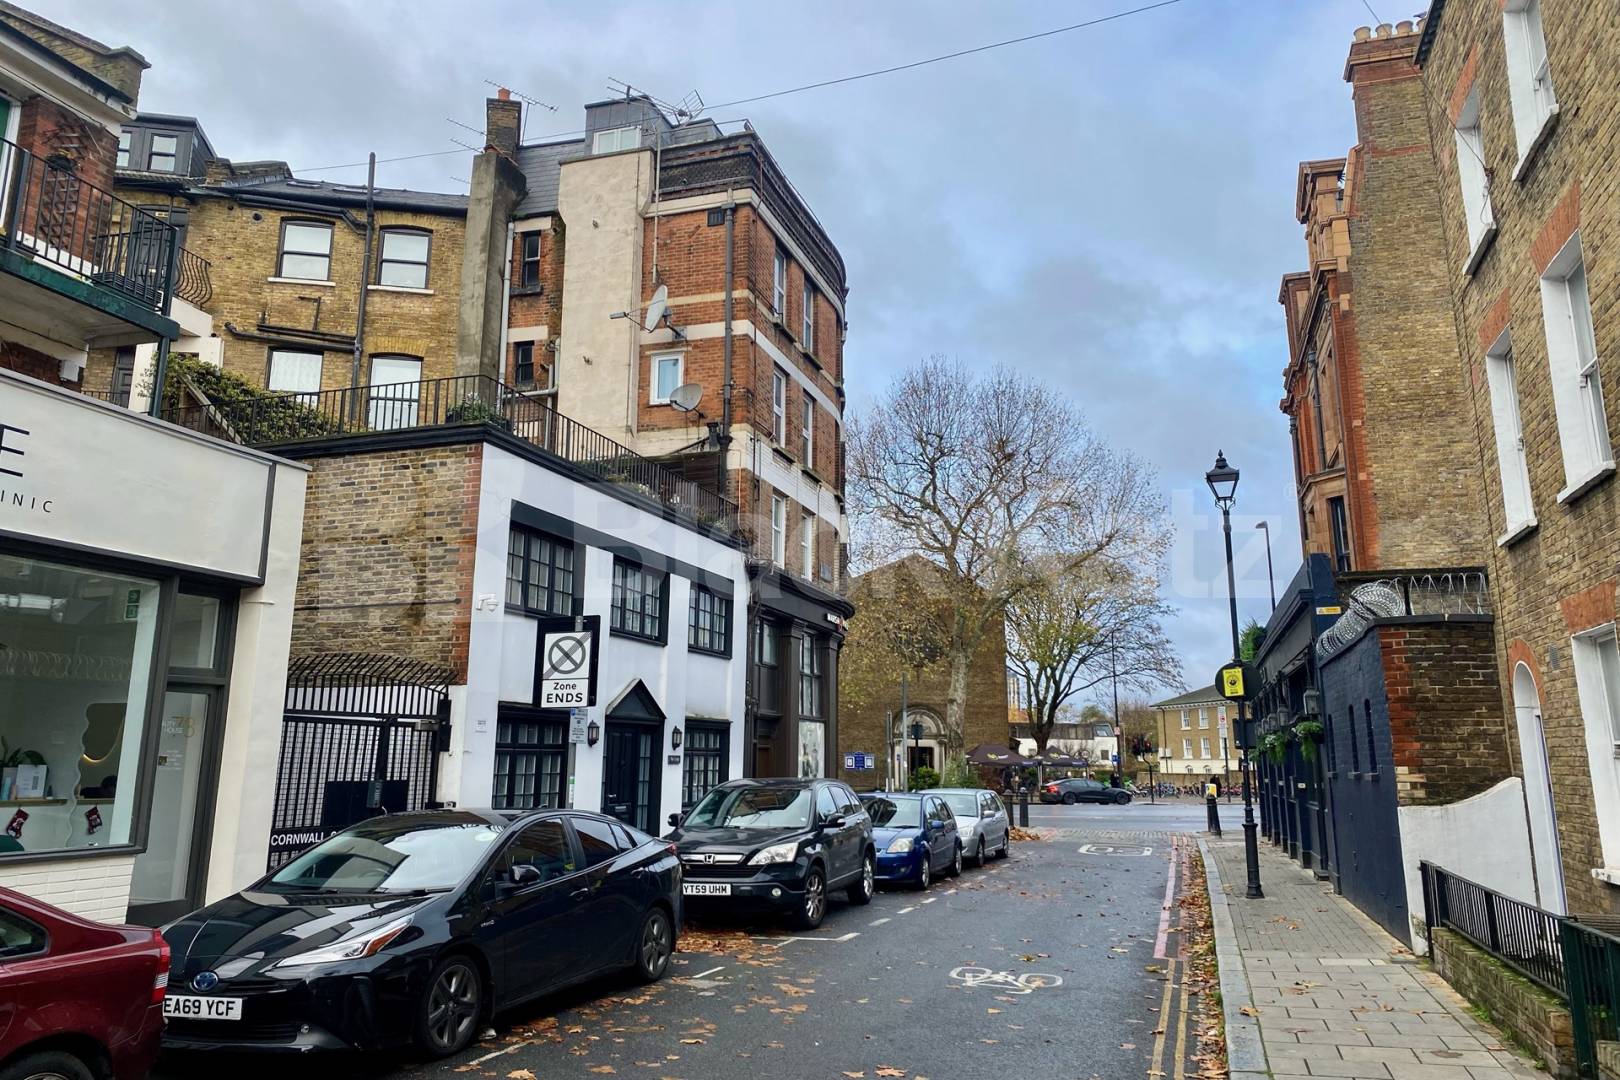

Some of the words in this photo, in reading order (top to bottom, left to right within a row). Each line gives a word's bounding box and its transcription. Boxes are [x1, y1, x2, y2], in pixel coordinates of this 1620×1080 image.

[553, 682, 577, 691] Zone
[546, 692, 583, 704] ENDS
[271, 832, 324, 846] CORNWALL
[683, 884, 707, 894] YT59
[709, 884, 728, 894] UHM
[163, 997, 202, 1015] EA69
[206, 999, 236, 1017] YCF
